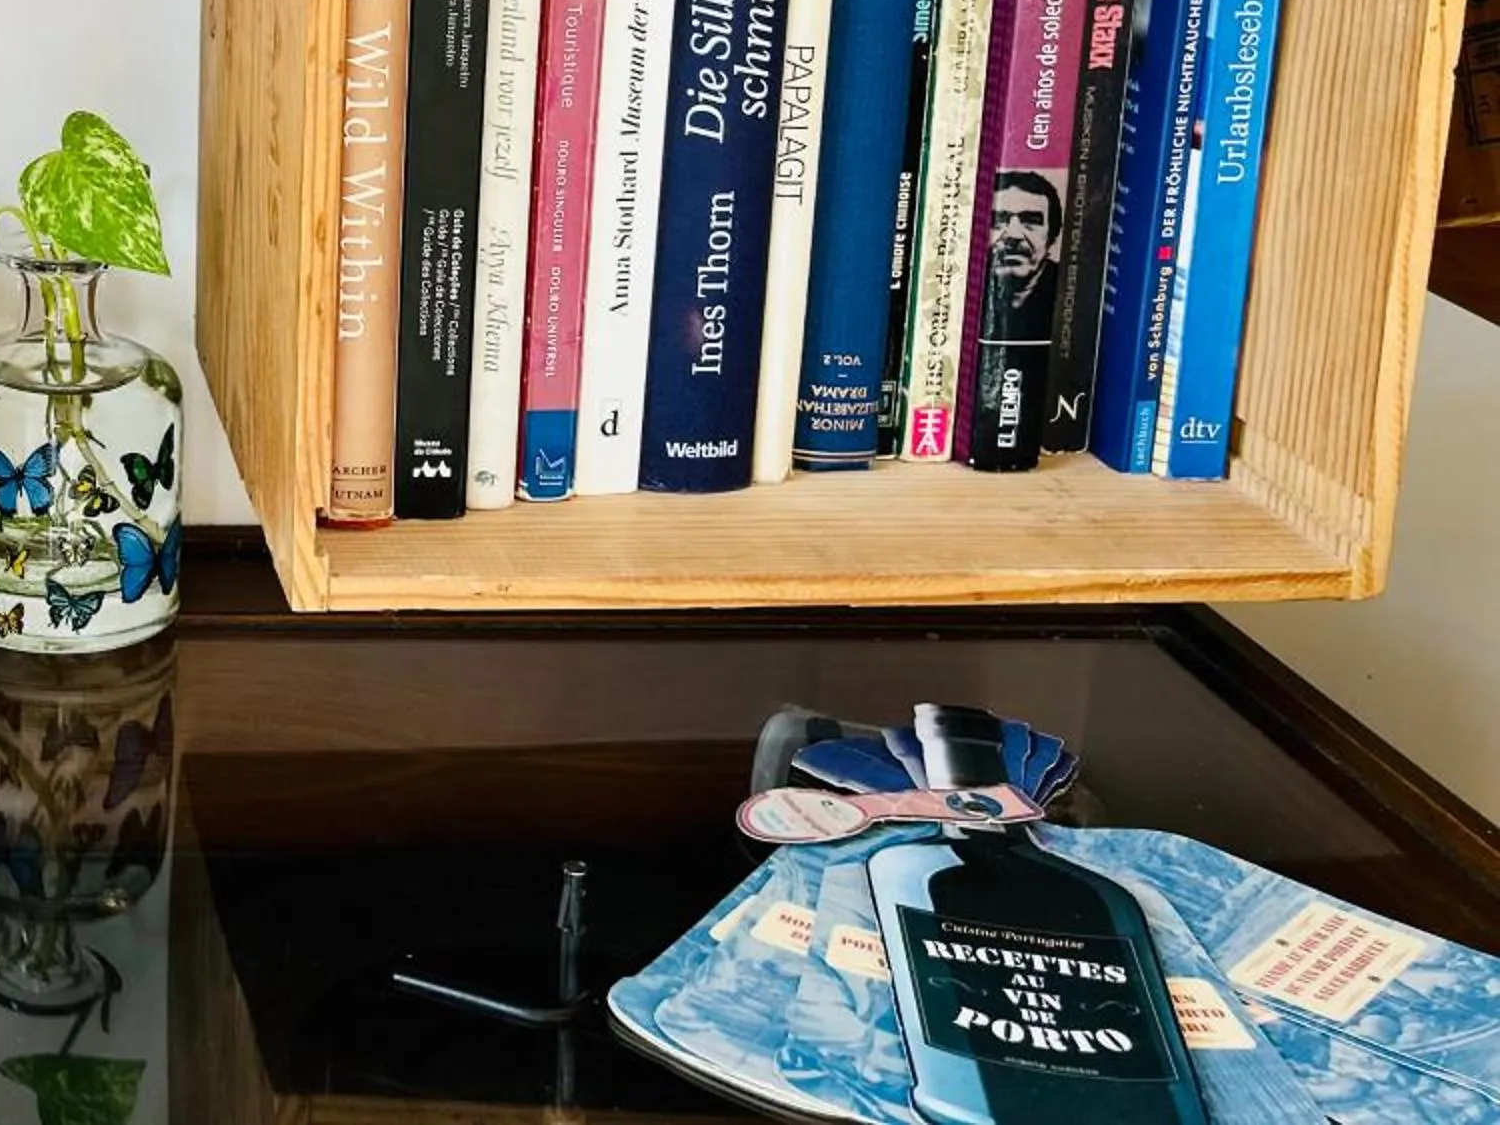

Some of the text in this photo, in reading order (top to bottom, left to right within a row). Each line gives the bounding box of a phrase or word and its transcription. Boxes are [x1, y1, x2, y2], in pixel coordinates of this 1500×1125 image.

[630, 0, 651, 49] der
[458, 32, 473, 89] Junqueiro
[561, 7, 585, 109] Touristique
[497, 69, 517, 121] voor
[619, 50, 649, 143] Museum
[685, 72, 727, 144] Die
[486, 123, 518, 182] jezelf
[555, 139, 570, 186] DOURO
[1164, 116, 1190, 209] FRÖHLICHE
[338, 25, 391, 344] Wild Within
[614, 151, 638, 250] Stothard
[552, 188, 568, 253] SINGULIER
[1161, 212, 1177, 239] DER
[548, 266, 564, 312] DOURO
[609, 253, 634, 317] Anna
[691, 190, 737, 376] Ines Thorn
[1148, 265, 1174, 348] Schönburg
[481, 293, 506, 375] Khema
[543, 315, 561, 378] UNIVERSEL
[823, 355, 862, 366] VOL. 2
[1145, 349, 1159, 381] von
[811, 384, 868, 398] DRAMA
[600, 411, 620, 437] d
[810, 418, 865, 431] MINOR
[1179, 417, 1221, 441] dtv
[665, 438, 738, 460] Weltbild
[921, 938, 1127, 984] RECETTES
[1010, 972, 1046, 989] AU
[1002, 987, 1063, 1012] VIN
[1019, 1007, 1057, 1026] DE
[952, 1005, 1134, 1054] PORTO
